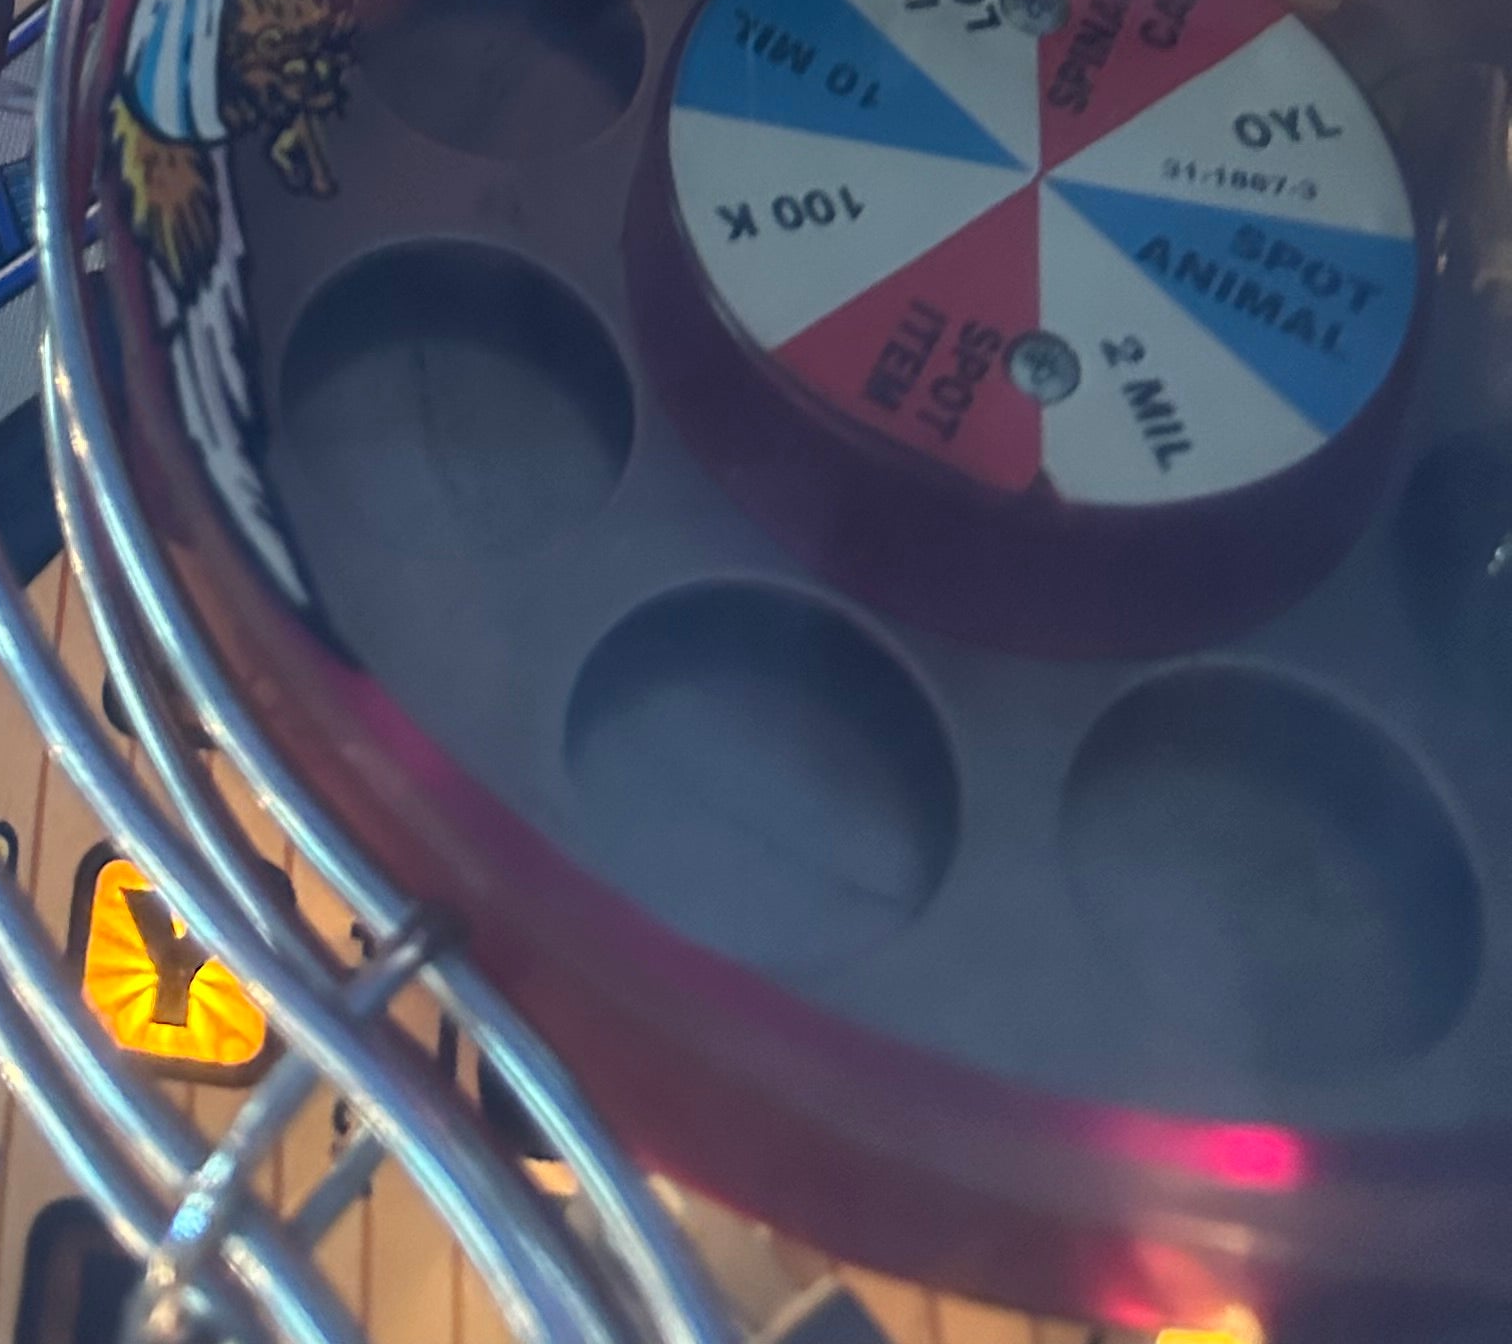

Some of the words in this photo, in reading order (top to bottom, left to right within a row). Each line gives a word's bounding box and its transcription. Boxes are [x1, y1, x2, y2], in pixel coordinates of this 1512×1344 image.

[732, 7, 816, 80] MIL
[826, 62, 881, 110] 10
[1231, 102, 1344, 153] OYL
[714, 201, 760, 243] K
[773, 183, 866, 231] 100
[1134, 233, 1352, 361] ANIMAL
[1229, 223, 1385, 316] SPOT
[865, 298, 947, 414] ITEM
[915, 319, 1004, 446] SPOT
[1098, 334, 1146, 370] 2
[1123, 378, 1197, 473] MIL
[120, 886, 213, 1027] Y
